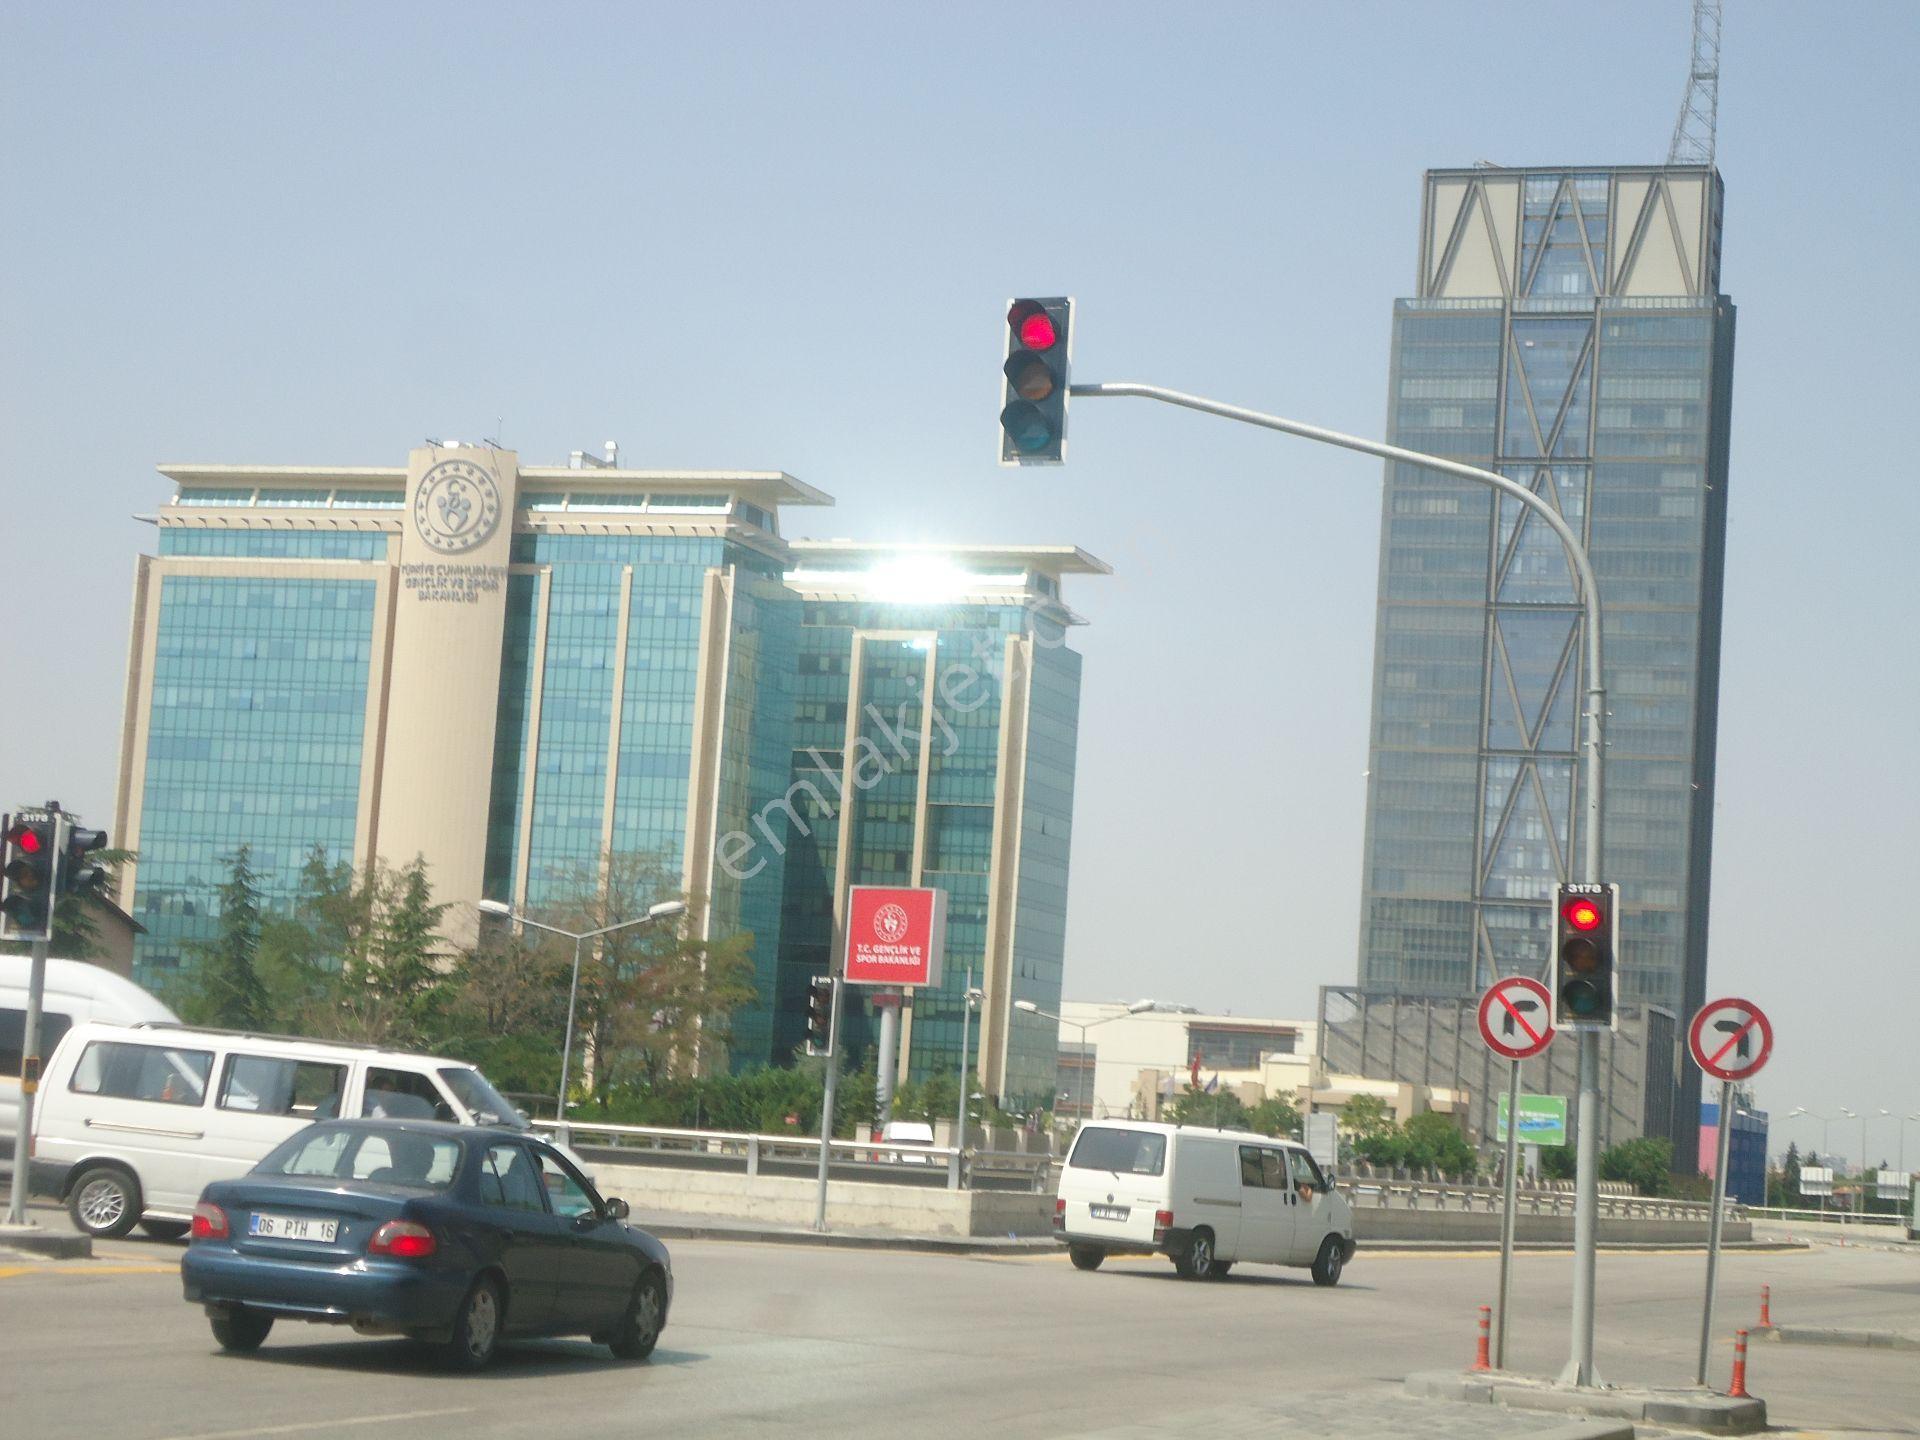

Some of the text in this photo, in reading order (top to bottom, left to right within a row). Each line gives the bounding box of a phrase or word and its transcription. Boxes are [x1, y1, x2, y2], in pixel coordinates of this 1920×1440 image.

[910, 946, 921, 956] VE
[856, 954, 878, 964] SPOR
[259, 1218, 275, 1234] 06
[285, 1220, 308, 1237] PTH
[320, 1223, 334, 1238] 16
